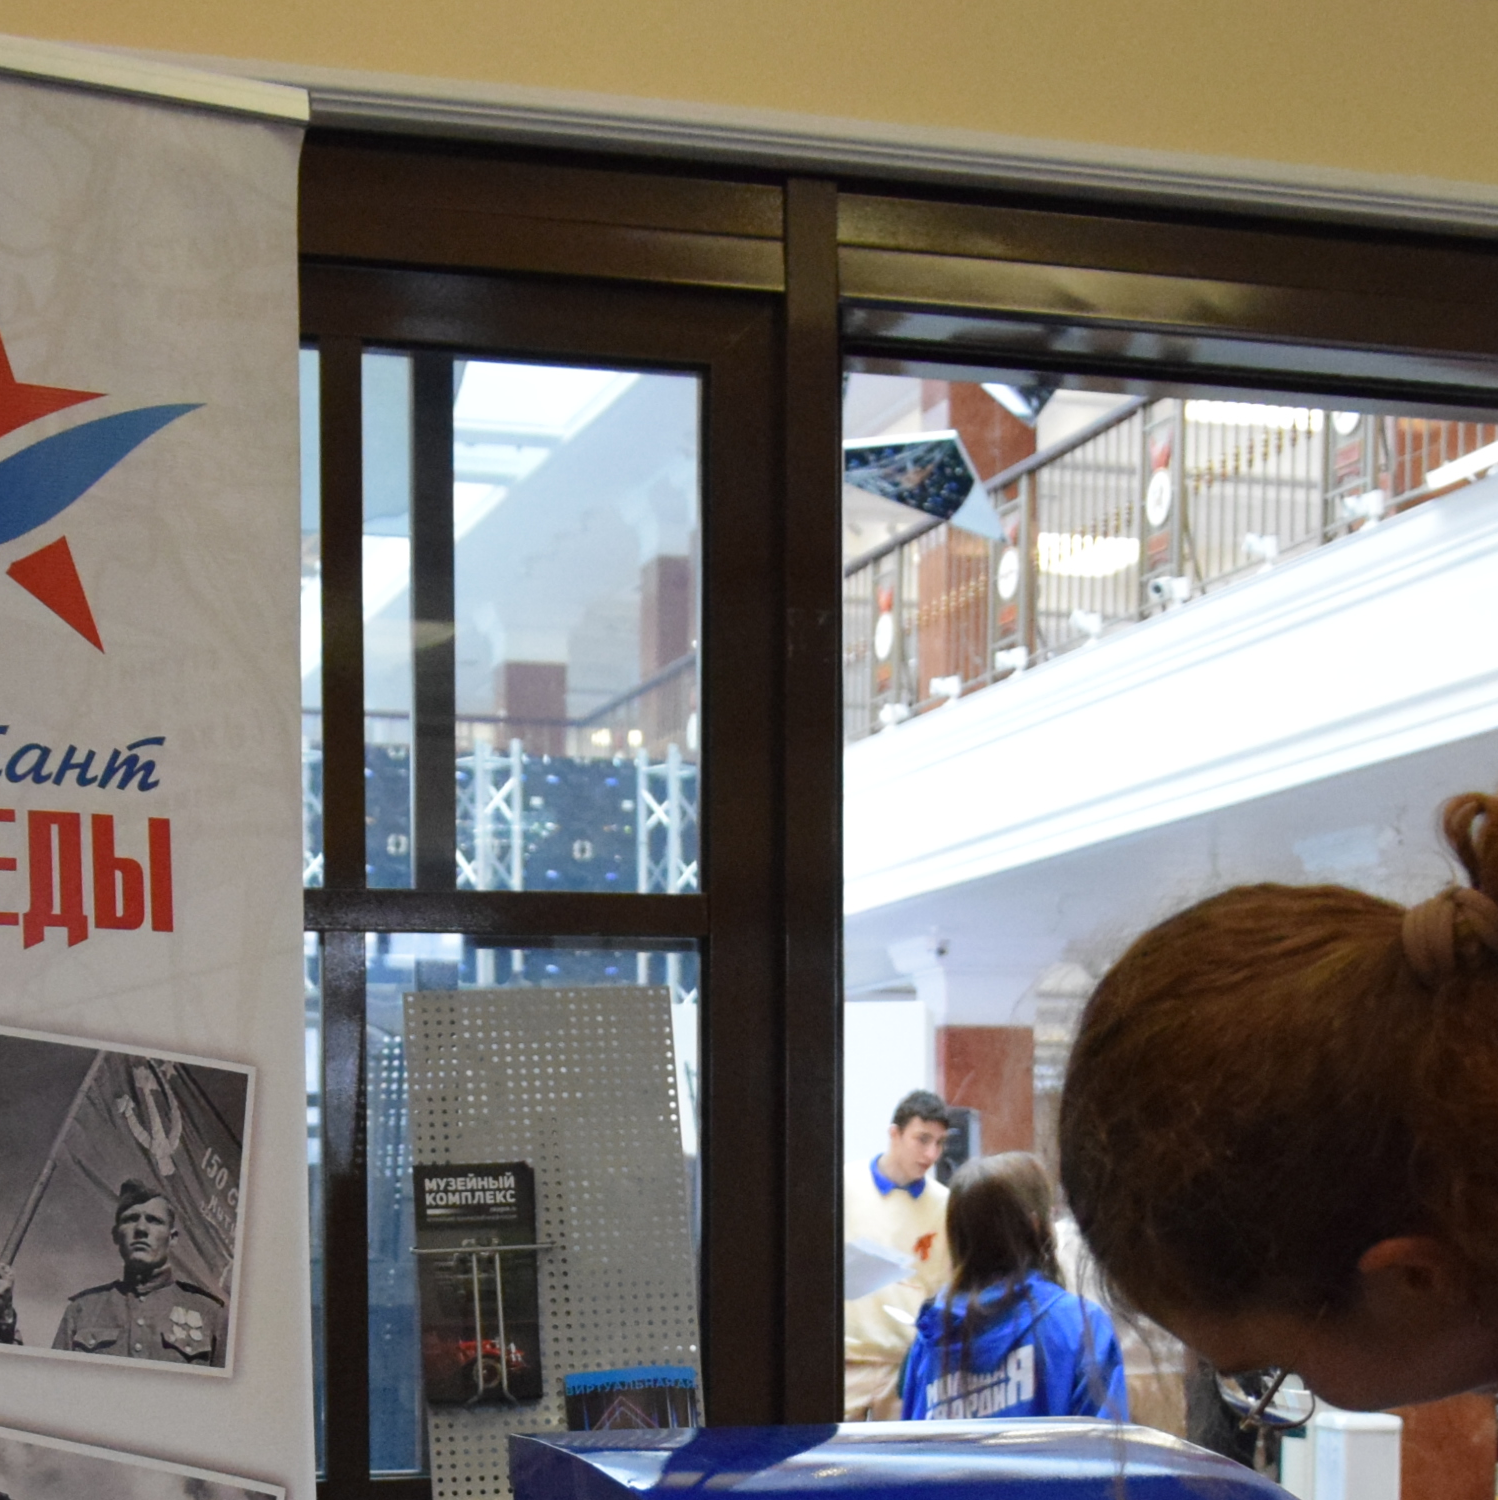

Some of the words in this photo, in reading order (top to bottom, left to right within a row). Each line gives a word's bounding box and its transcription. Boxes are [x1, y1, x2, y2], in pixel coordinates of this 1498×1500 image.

[201, 1147, 229, 1190] 150
[424, 1172, 515, 1191] МУЗЕЙНЫЙ
[425, 1190, 516, 1206] КОМПЛЕКС
